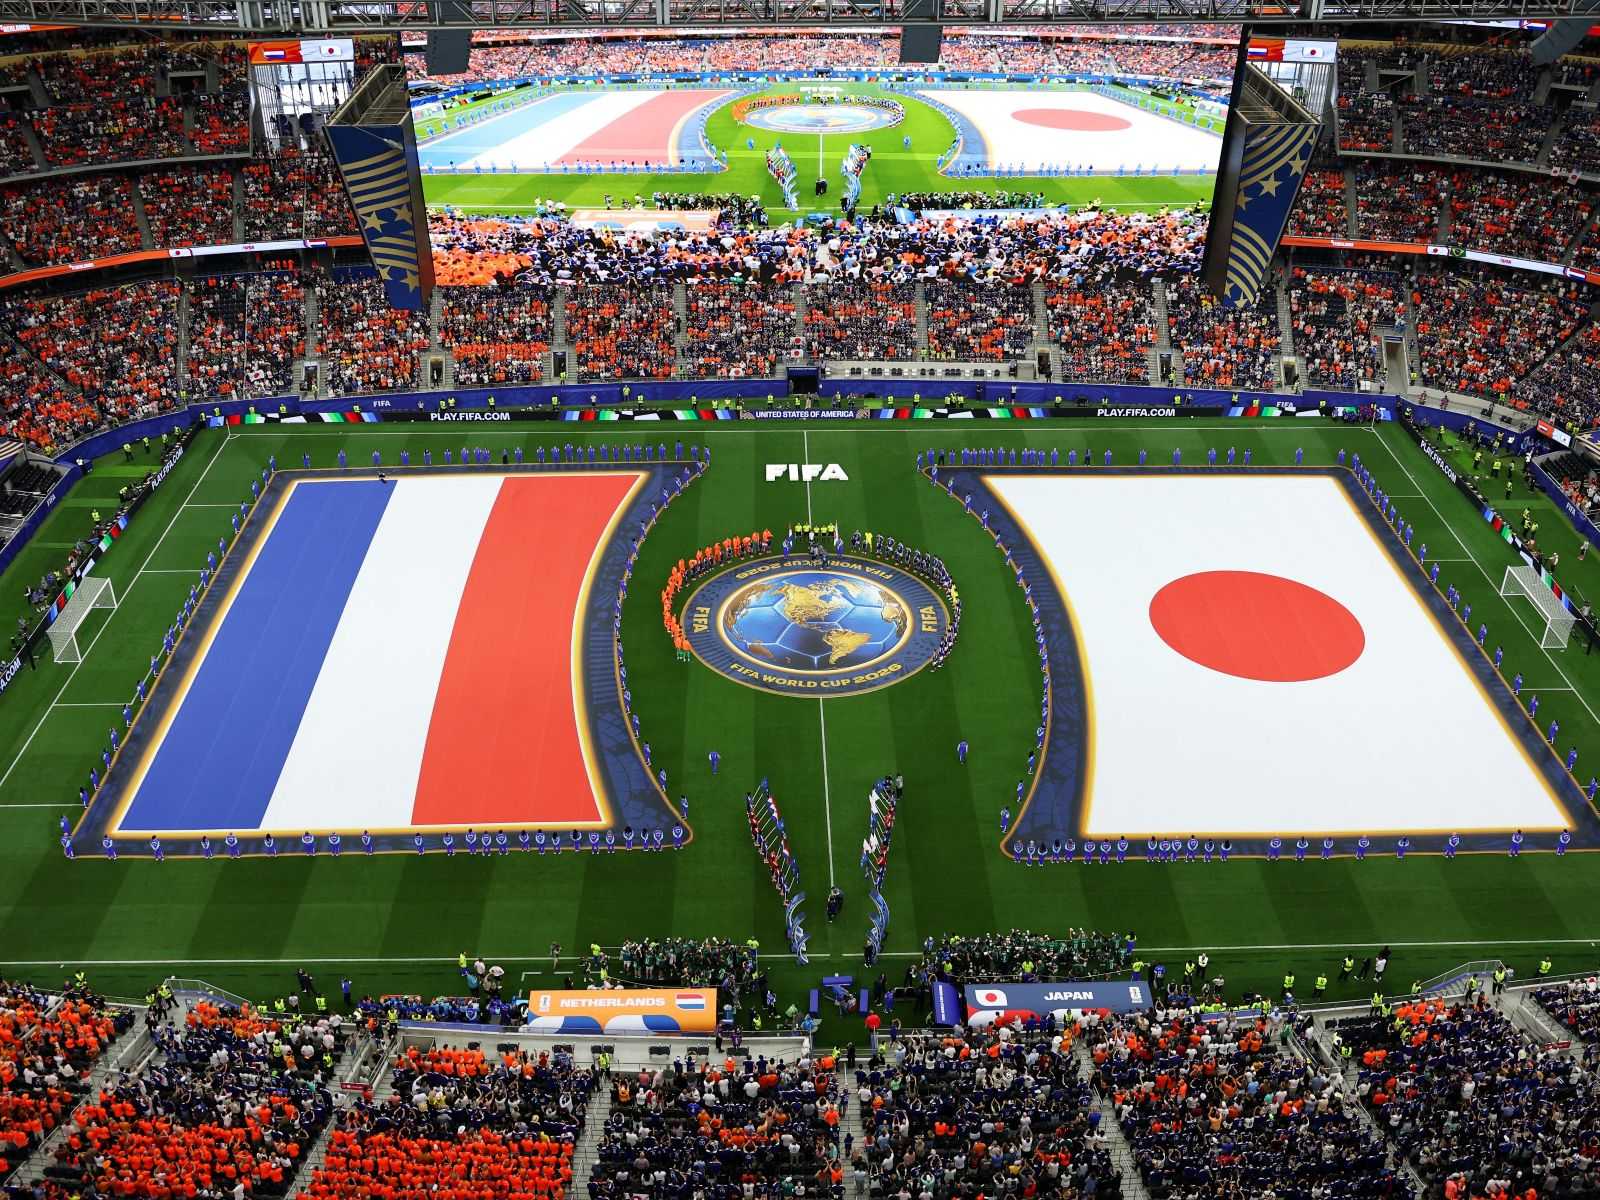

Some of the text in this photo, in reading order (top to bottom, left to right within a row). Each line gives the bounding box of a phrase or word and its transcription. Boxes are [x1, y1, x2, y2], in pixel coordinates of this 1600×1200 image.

[373, 400, 391, 408] FIFA
[430, 412, 511, 421] PLAY.FIFA.COM
[755, 410, 855, 418] UNITED STATES OF AMERICA
[1097, 408, 1176, 417] PLAY.FIFA.COM
[151, 447, 184, 490] PLAY.FIFA.COM
[1420, 439, 1457, 484] PLAY.FIFA.COM
[765, 463, 849, 481] FIFA
[1566, 502, 1577, 517] FIFA
[692, 606, 712, 634] FIFA
[919, 604, 938, 633] FIFA
[729, 662, 904, 689] FIFA WORLD CUP 2026
[559, 996, 666, 1008] NETHERLANDS
[1043, 991, 1094, 1001] JAPAN
